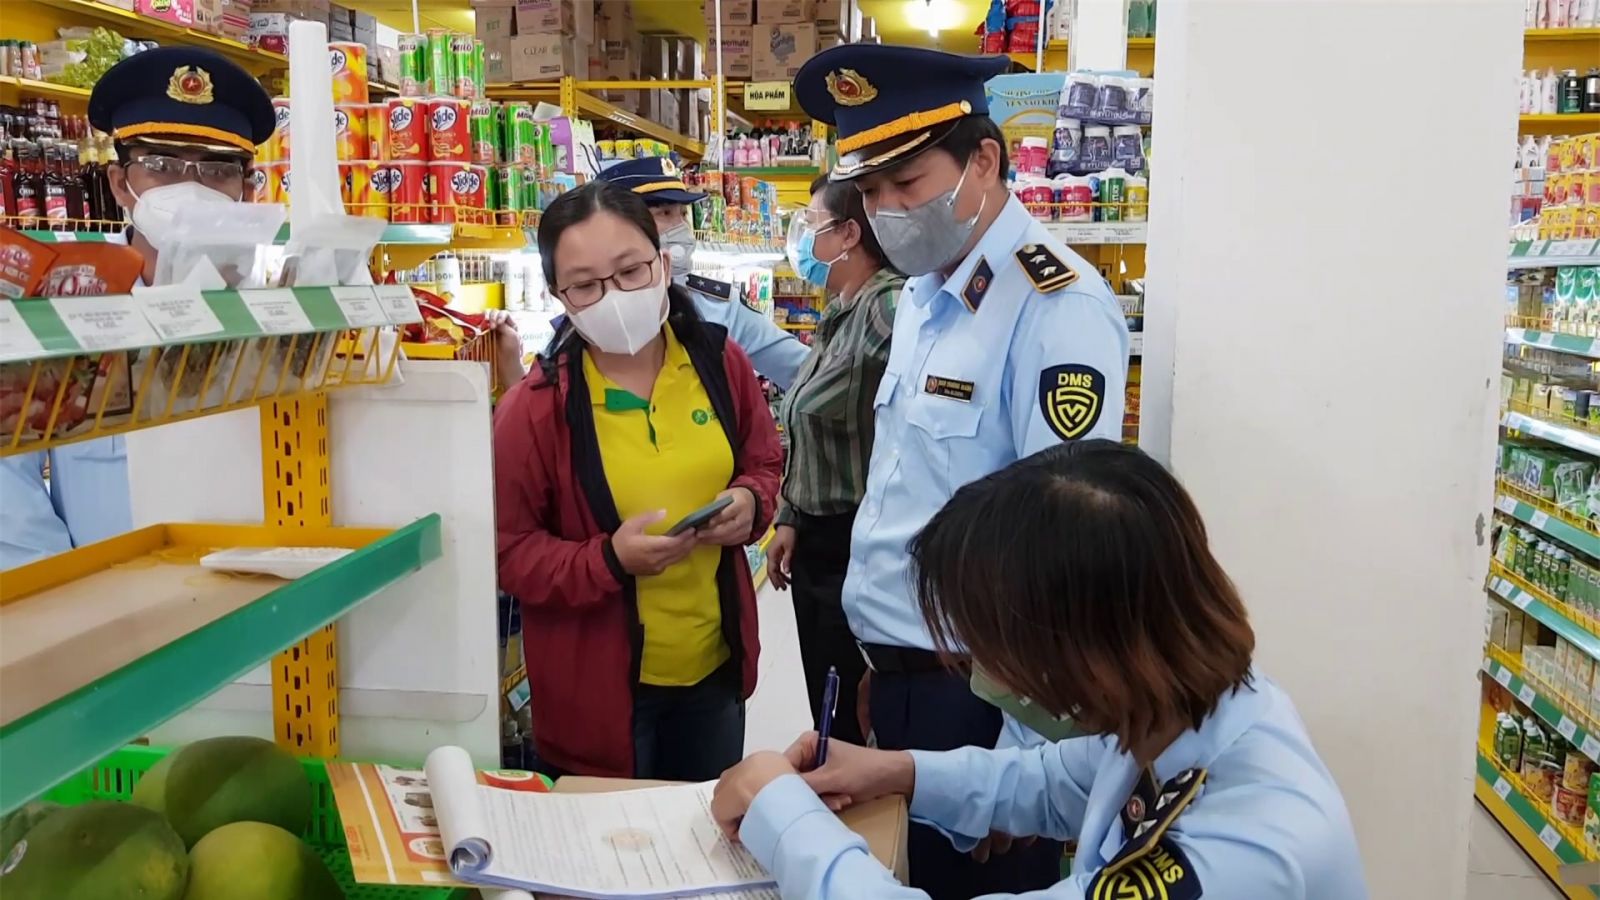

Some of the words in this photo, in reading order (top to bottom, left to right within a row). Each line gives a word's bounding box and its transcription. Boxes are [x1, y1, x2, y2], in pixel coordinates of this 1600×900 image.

[453, 44, 473, 52] MILO
[709, 38, 749, 47] Shwermate
[749, 89, 763, 99] HÓA
[765, 88, 785, 99] PHẨM
[390, 109, 410, 128] Slide
[431, 109, 453, 128] Slide
[470, 108, 490, 116] MILO
[371, 170, 391, 191] Slid
[452, 170, 469, 191] Slid
[1058, 373, 1093, 387] DMS
[1147, 845, 1184, 884] DMS
